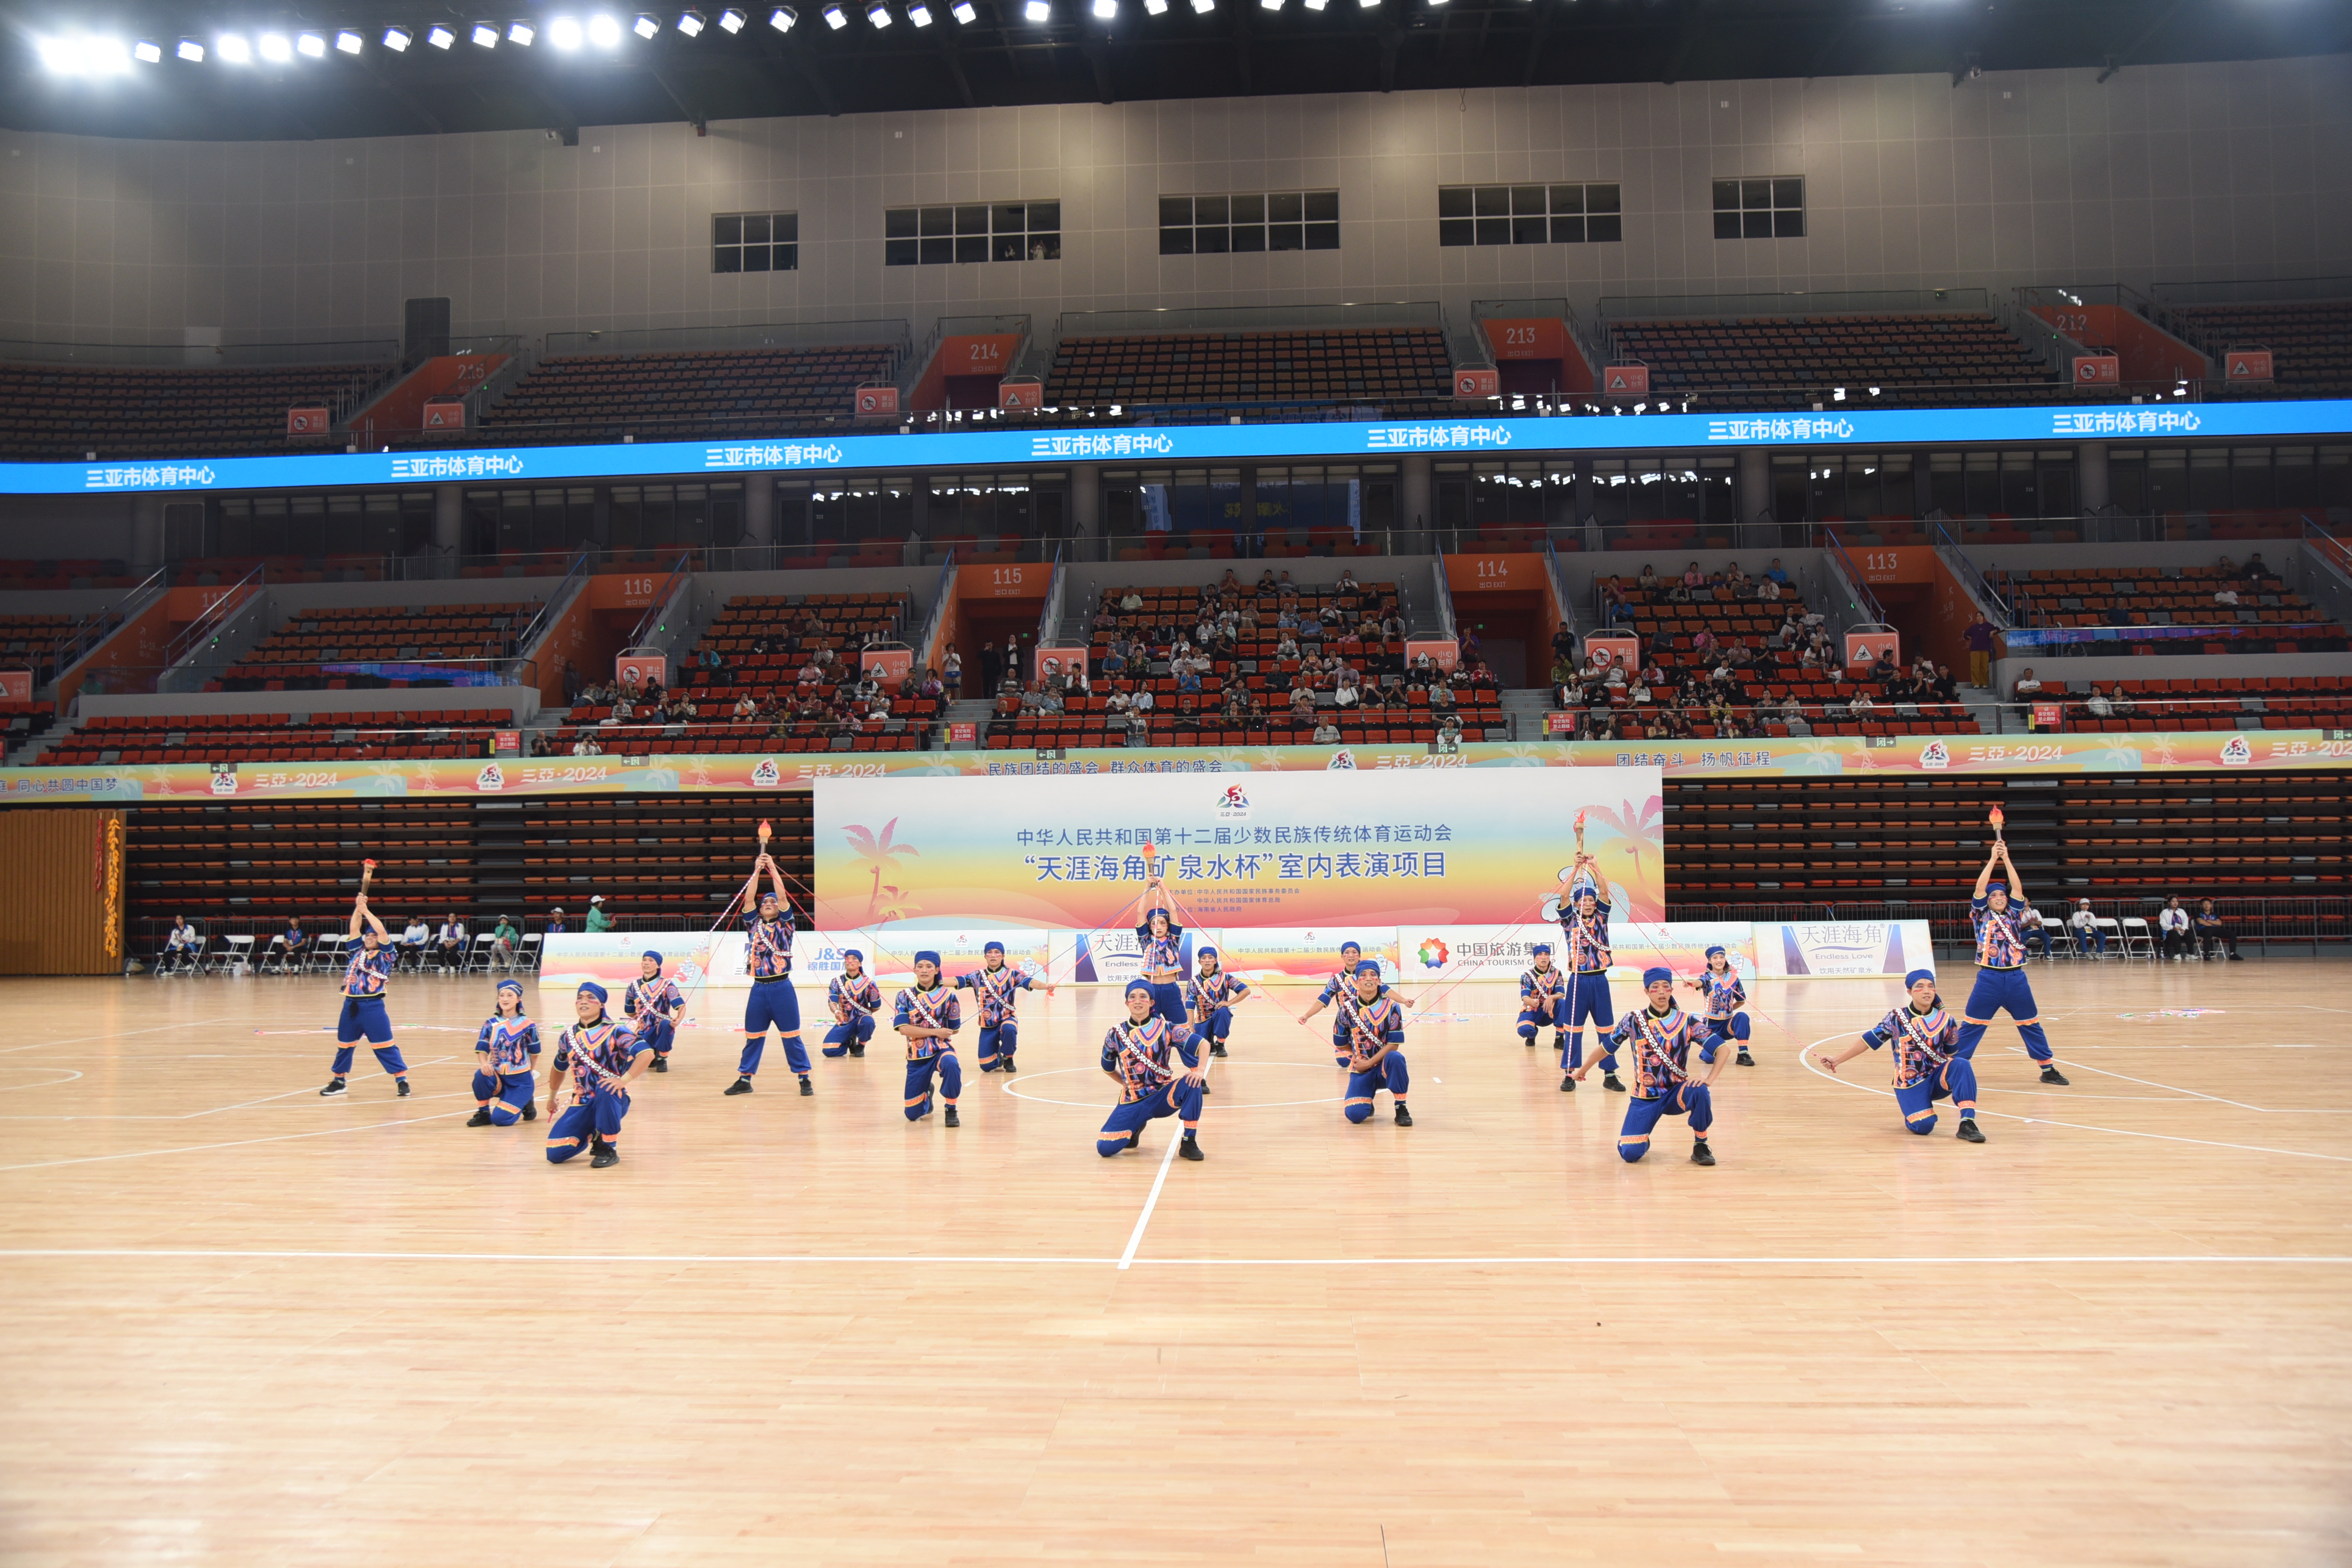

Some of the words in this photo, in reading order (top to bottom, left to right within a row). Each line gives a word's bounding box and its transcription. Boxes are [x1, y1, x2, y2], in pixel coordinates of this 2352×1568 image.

[2057, 314, 2087, 330] 212
[1506, 327, 1535, 344] 213
[971, 344, 999, 360] 214
[1708, 417, 1854, 440] 三亚市体育中心
[2053, 410, 2201, 434] 三亚市体育中心
[1032, 433, 1173, 456] 三亚市体育中心
[1367, 425, 1512, 448] 三亚市体育中心
[705, 444, 842, 467] 三亚市体育中心
[391, 455, 523, 478] 三亚市体育中心
[86, 466, 215, 487] 三亚市体育中心
[1477, 560, 1508, 577] 114
[1867, 553, 1897, 570] 113
[994, 568, 1022, 584] 115
[624, 579, 652, 595] 116
[1438, 658, 1453, 666] 台阶
[1616, 752, 1686, 767] 团结奋斗
[1701, 750, 1771, 767] 扬帆征程
[989, 761, 1099, 776] 民族团结的盛会
[1110, 759, 1223, 774] 群众体育的盛会
[18, 777, 118, 793] 同心共圆中国梦
[1017, 824, 1452, 847] 中华人民共和国第十二届少数民族传统体育运动会
[1801, 924, 1882, 945] 天涯海角
